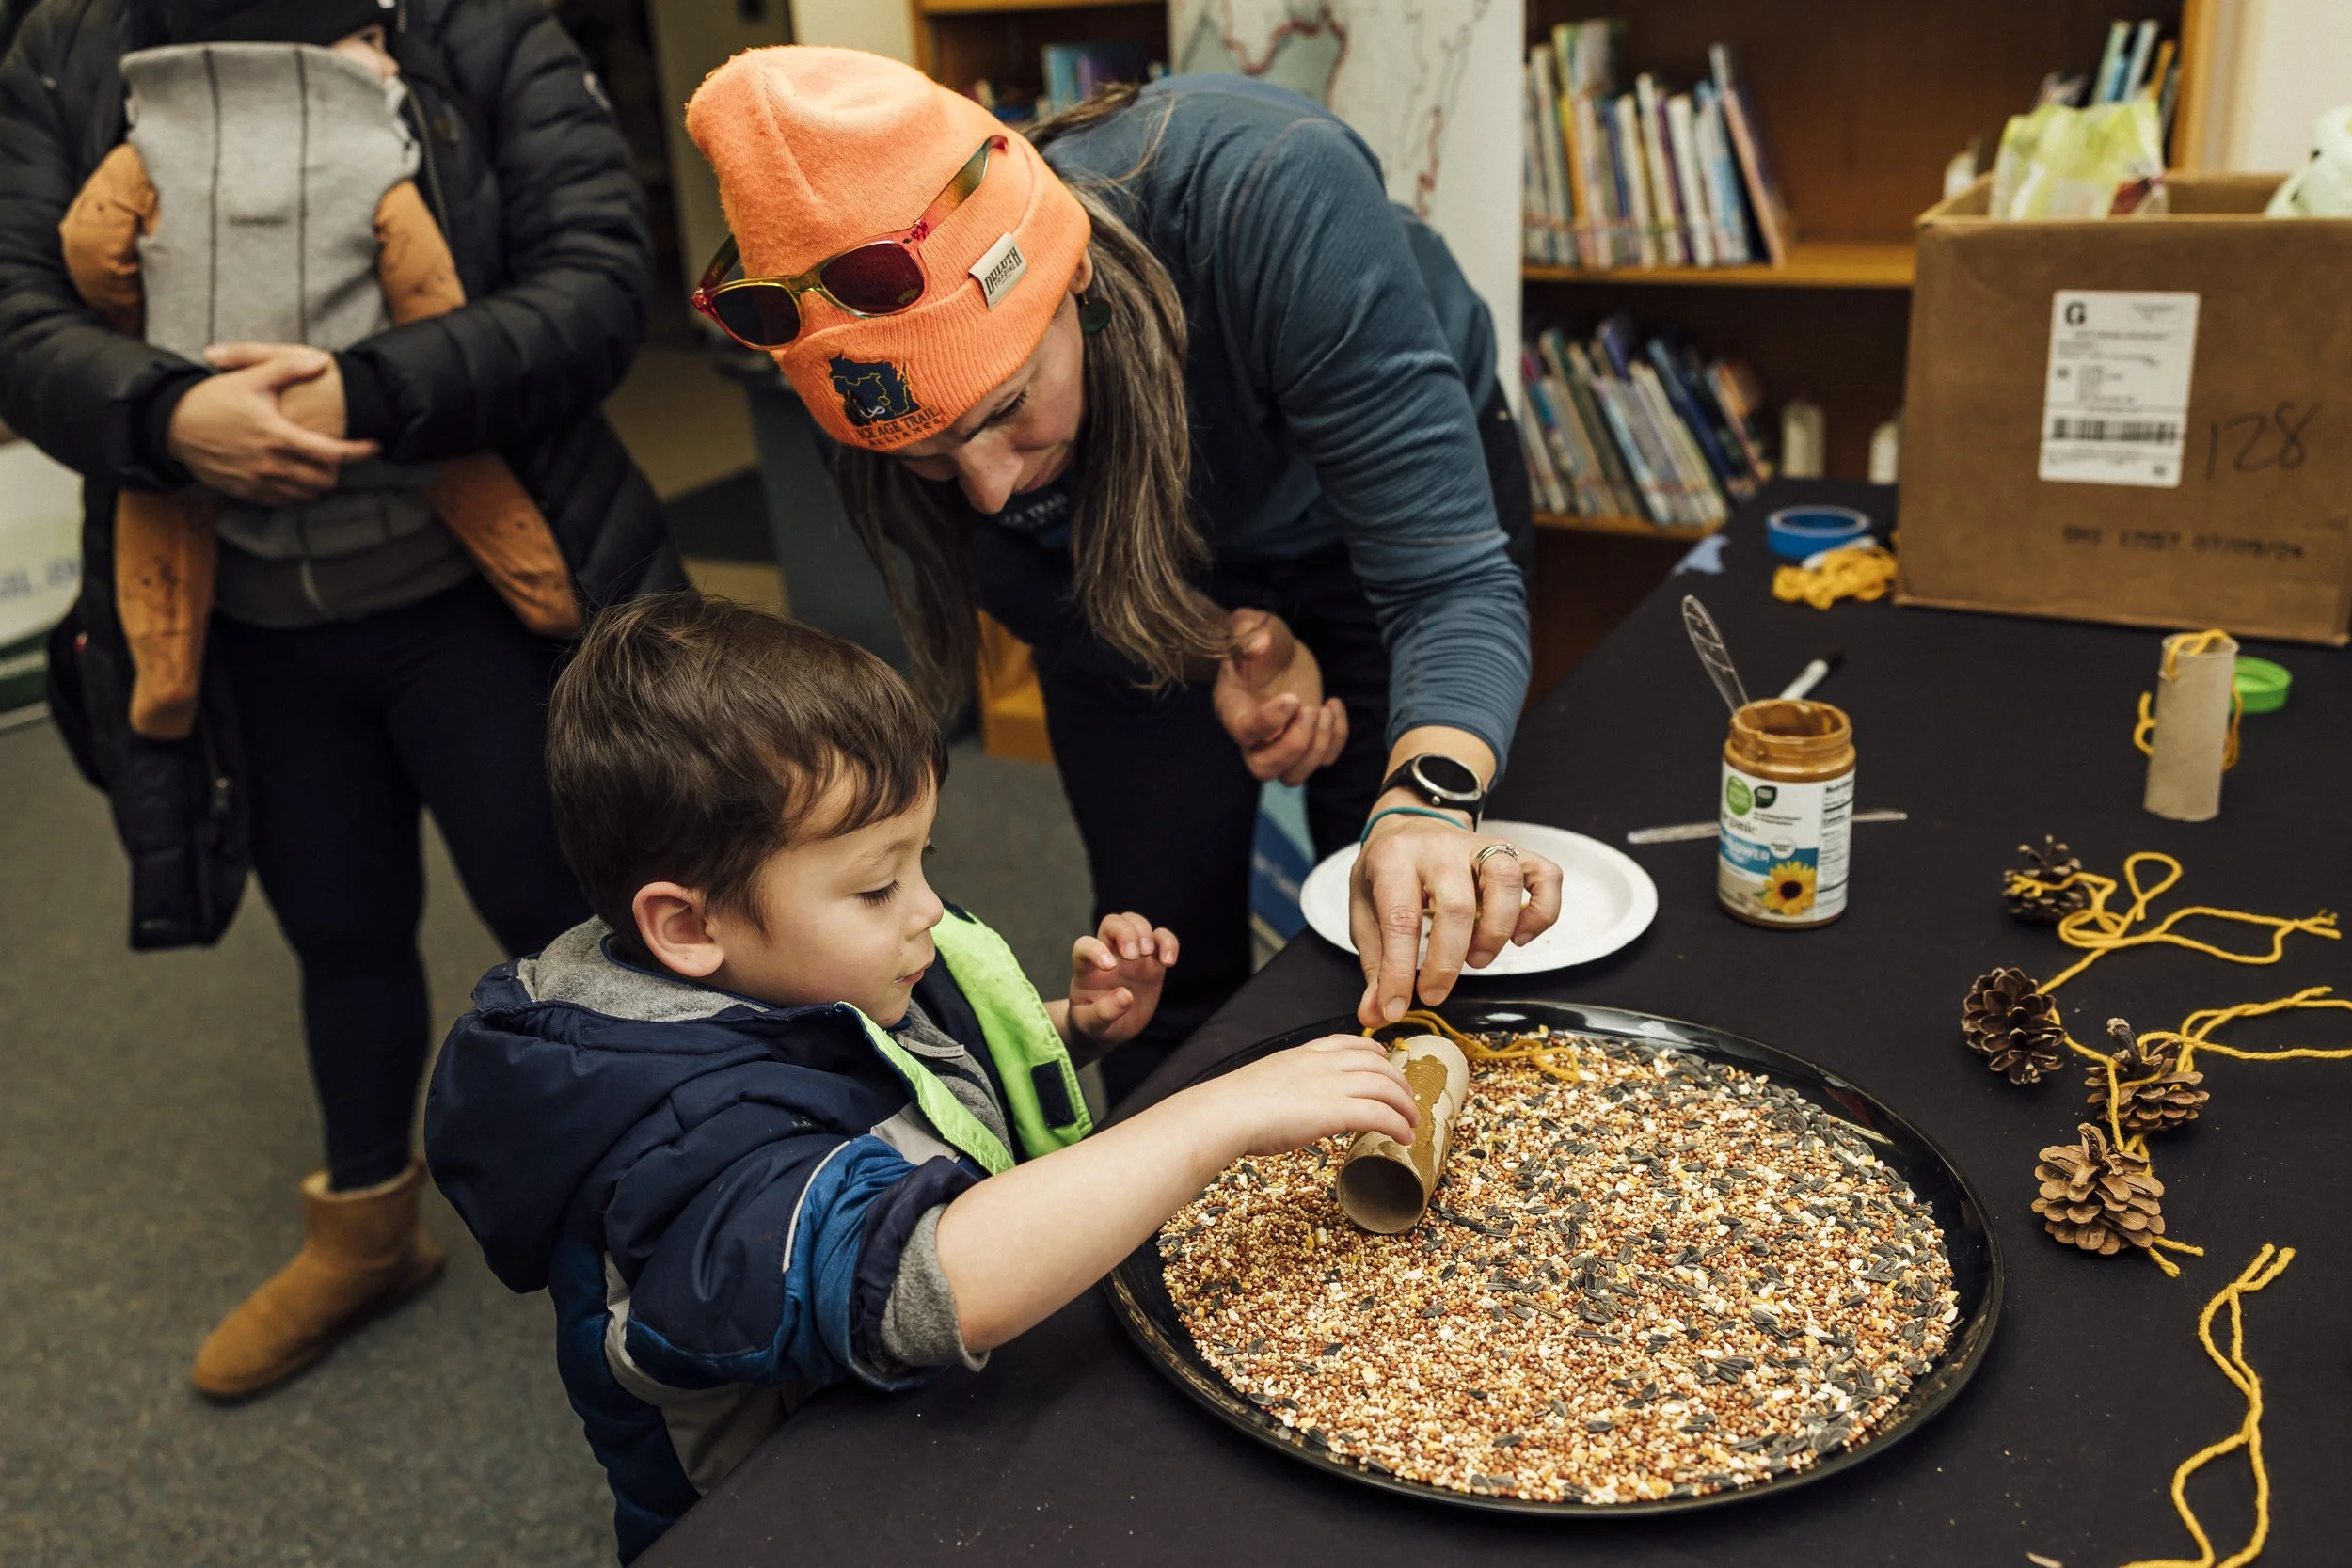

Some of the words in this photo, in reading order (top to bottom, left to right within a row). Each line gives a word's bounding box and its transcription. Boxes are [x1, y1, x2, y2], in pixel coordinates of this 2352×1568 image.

[984, 246, 1022, 296] DULUTH
[994, 264, 1017, 288] TRADING
[856, 426, 876, 439] ICE
[877, 420, 903, 436] AGE
[900, 407, 940, 429] TRAIL
[868, 418, 941, 446] ALLIANCE
[2206, 400, 2324, 480] 128
